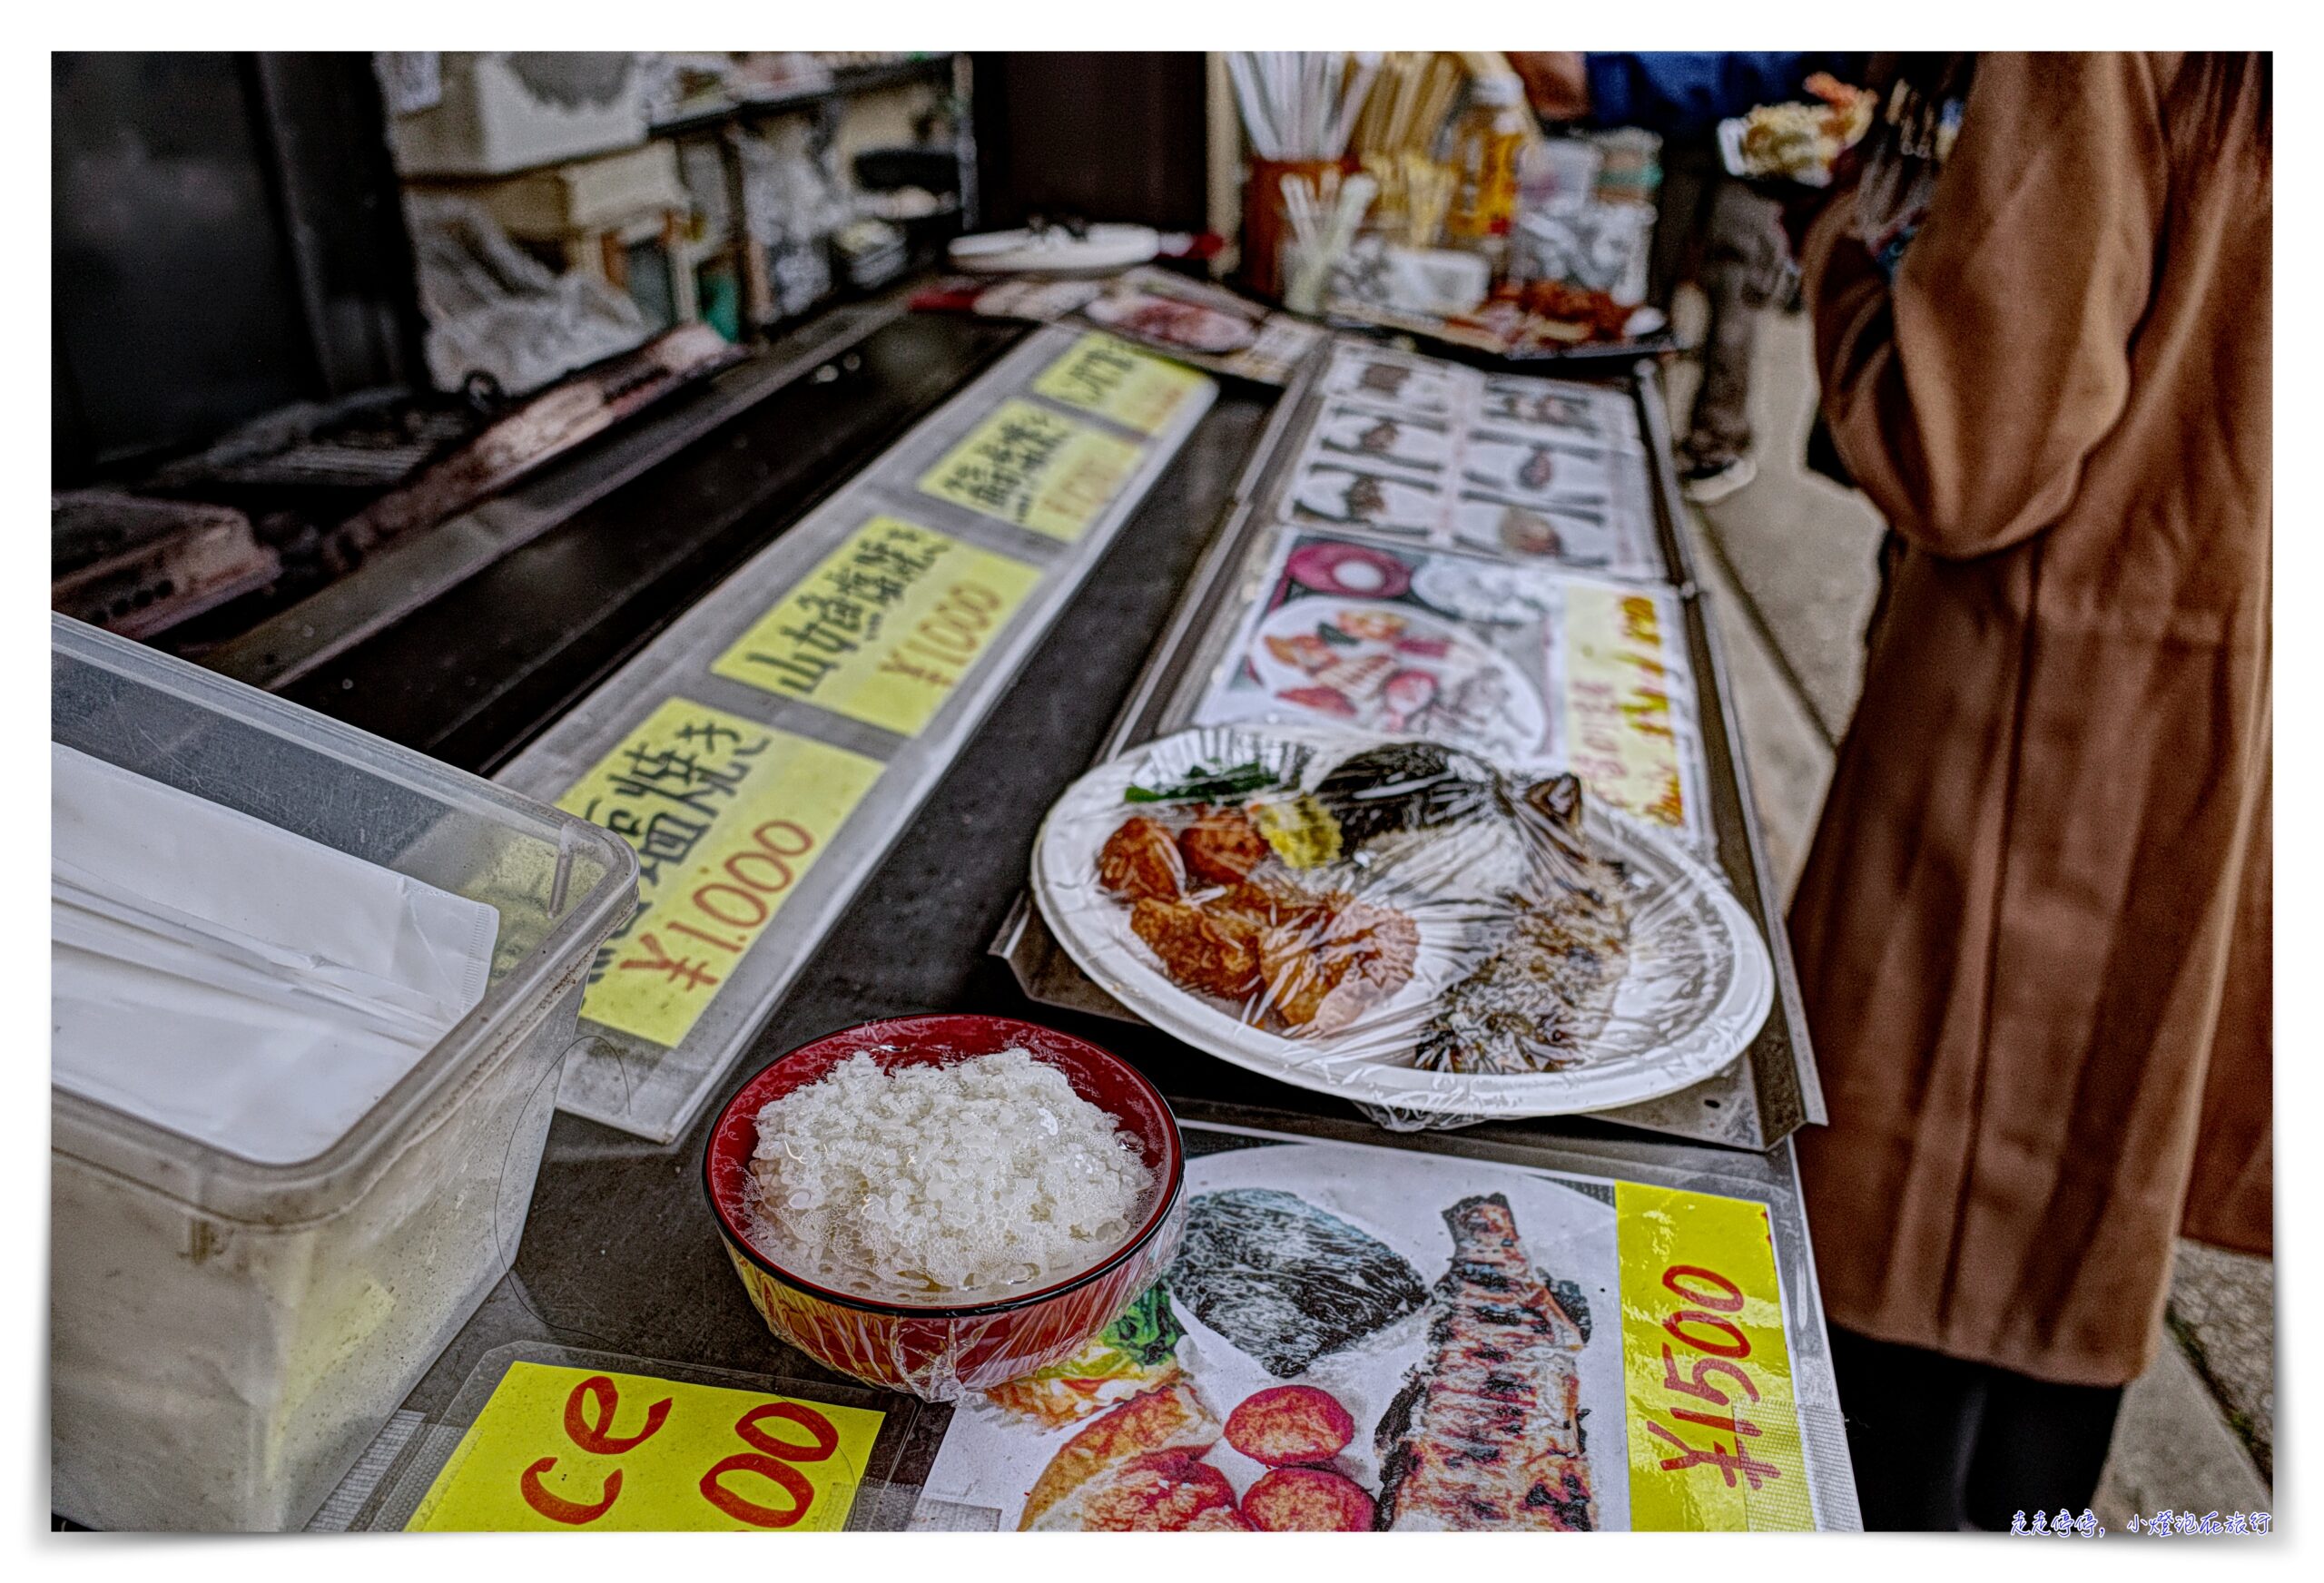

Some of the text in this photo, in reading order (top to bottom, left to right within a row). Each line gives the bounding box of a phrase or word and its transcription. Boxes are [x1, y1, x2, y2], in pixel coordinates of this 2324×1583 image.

[581, 723, 772, 989] 塩焼き
[699, 1401, 840, 1531] 00
[1646, 1264, 1782, 1490] ¥1500
